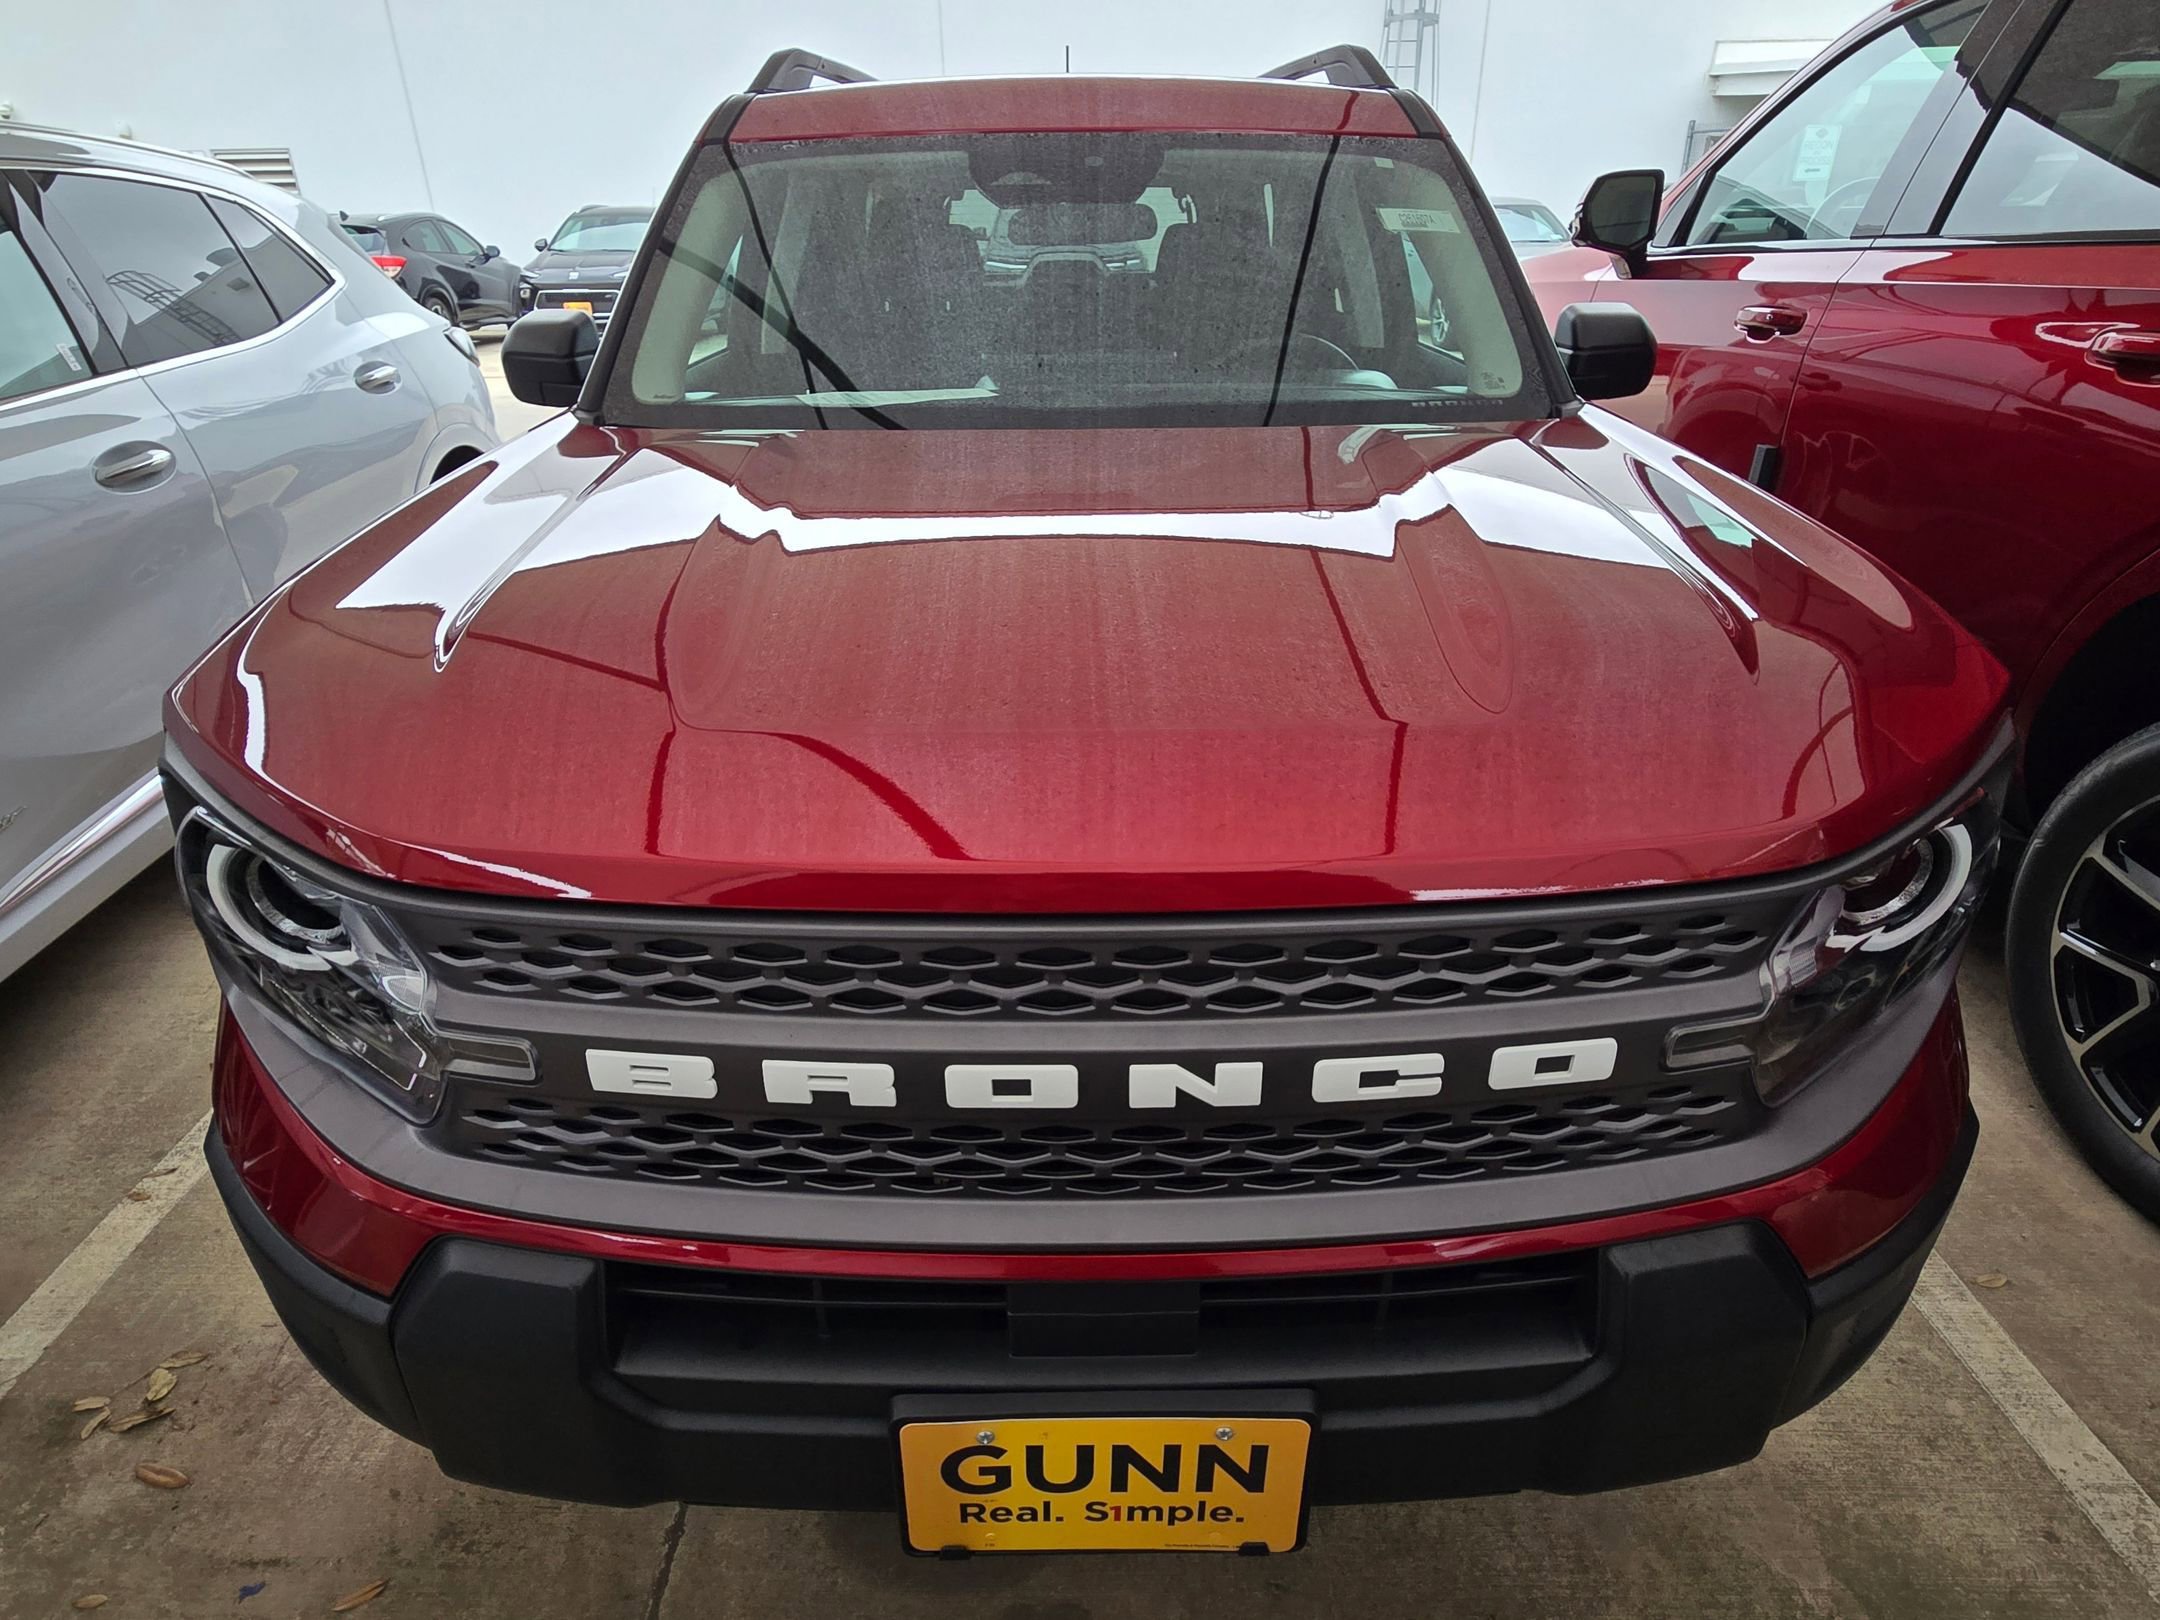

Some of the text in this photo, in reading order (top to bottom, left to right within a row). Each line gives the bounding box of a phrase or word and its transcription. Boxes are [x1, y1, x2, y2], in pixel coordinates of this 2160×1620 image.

[585, 1037, 1618, 1109] BRONCO
[940, 1444, 1269, 1495] GUNN
[959, 1500, 1064, 1523] Real.
